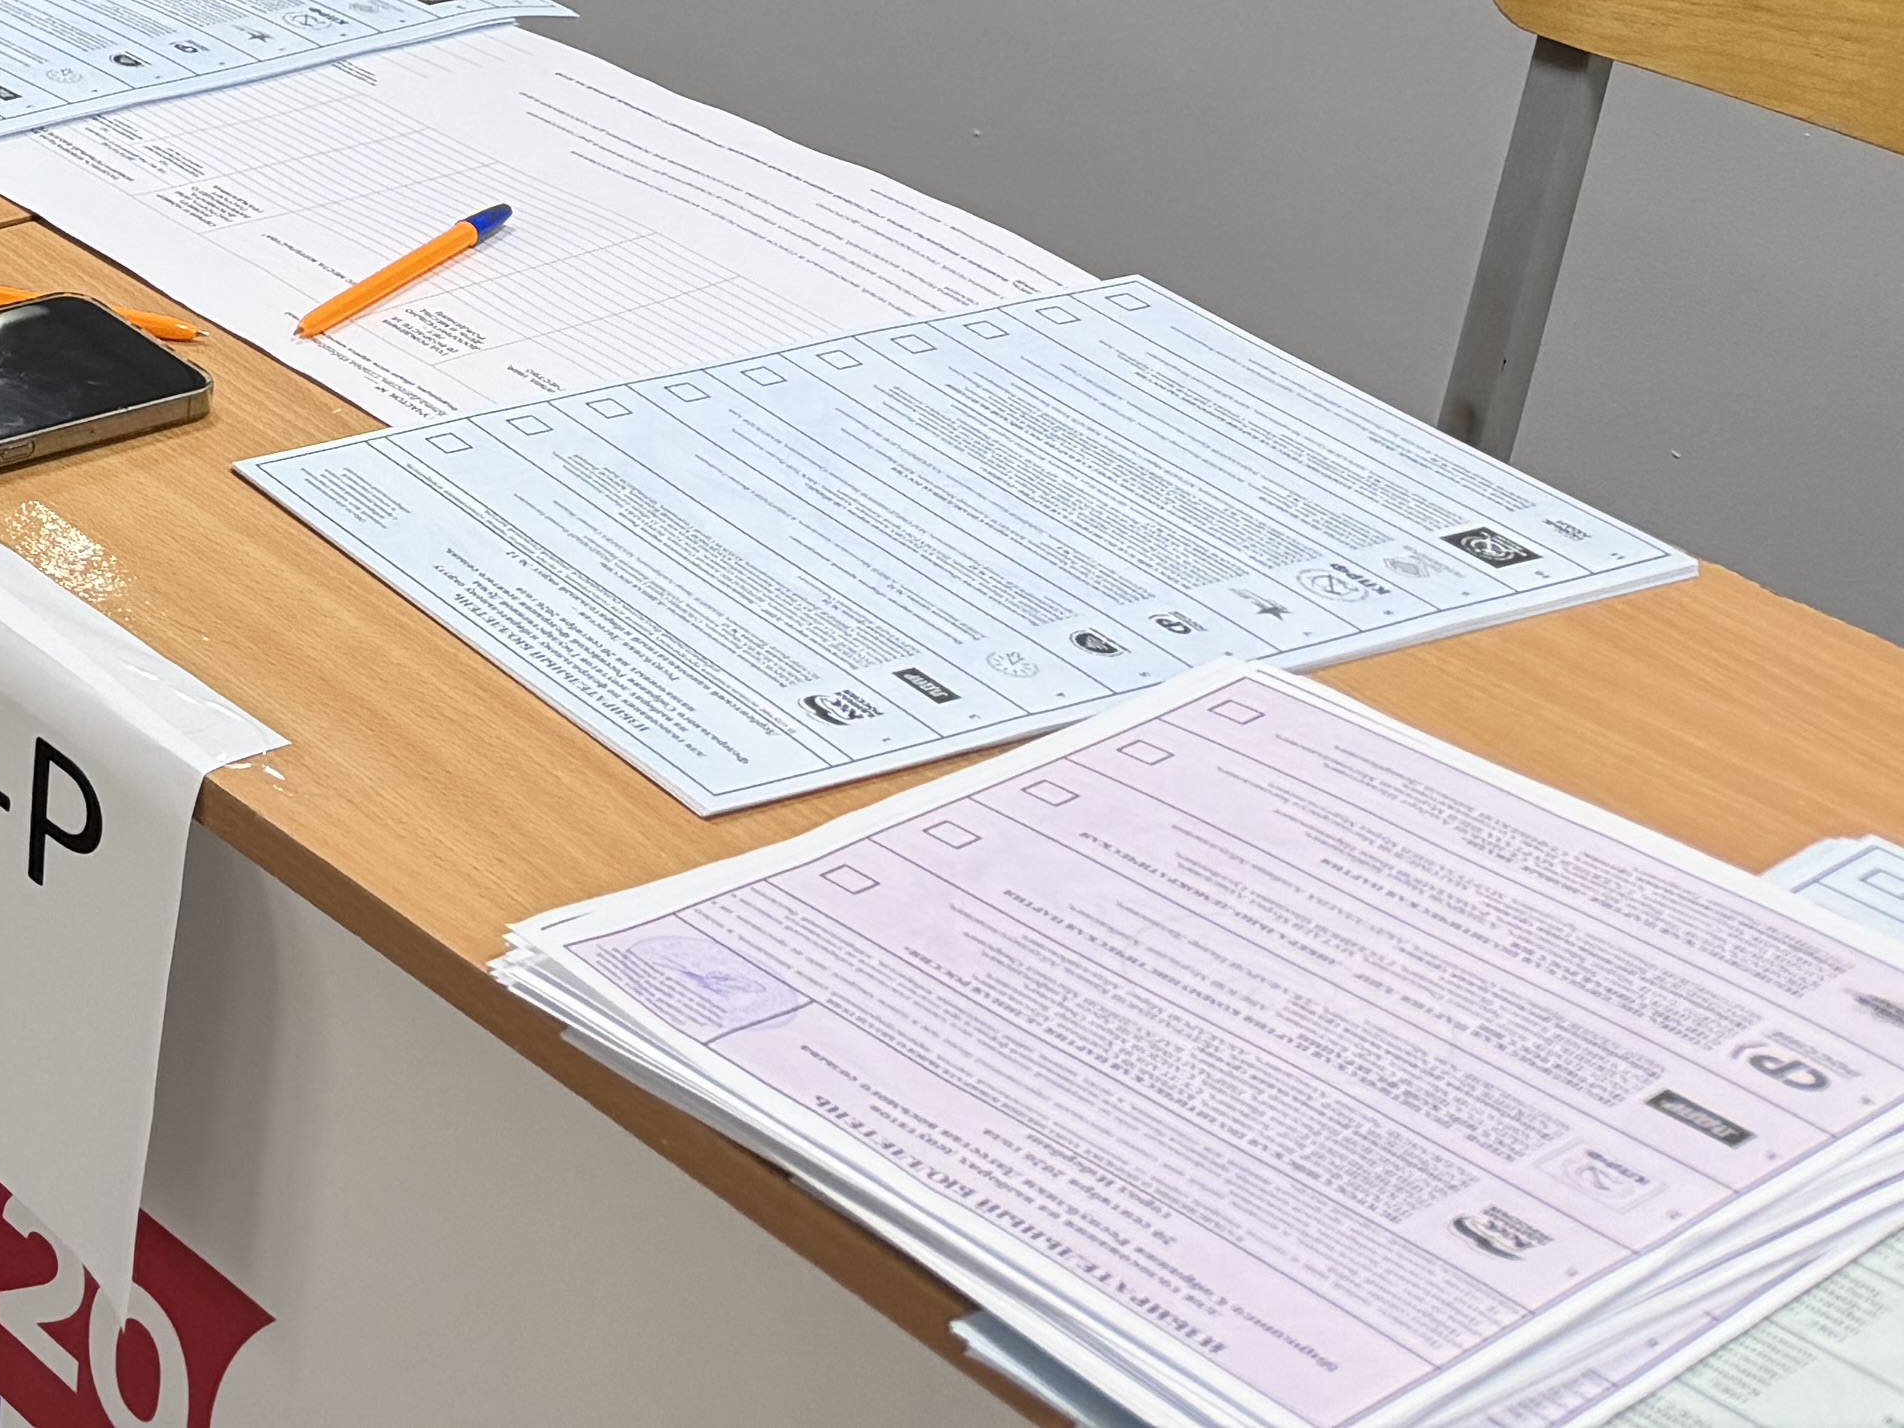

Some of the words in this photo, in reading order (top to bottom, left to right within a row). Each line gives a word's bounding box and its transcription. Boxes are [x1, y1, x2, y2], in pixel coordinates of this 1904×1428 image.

[1325, 561, 1392, 595] КПРФ
[447, 592, 536, 650] БЮЛЛЕТЕНЬ
[528, 650, 652, 732] ИЗБИРАТЕЛЬНЫЙ
[804, 1092, 979, 1200] БЮЛЛЕТЕНЬ
[934, 1126, 1025, 1181] Дагестан
[1018, 1151, 1068, 1180] 2026
[1015, 1175, 1135, 1248] Республики
[969, 1194, 1229, 1356] ИЗБИРАТЕЛЬНЫЙ
